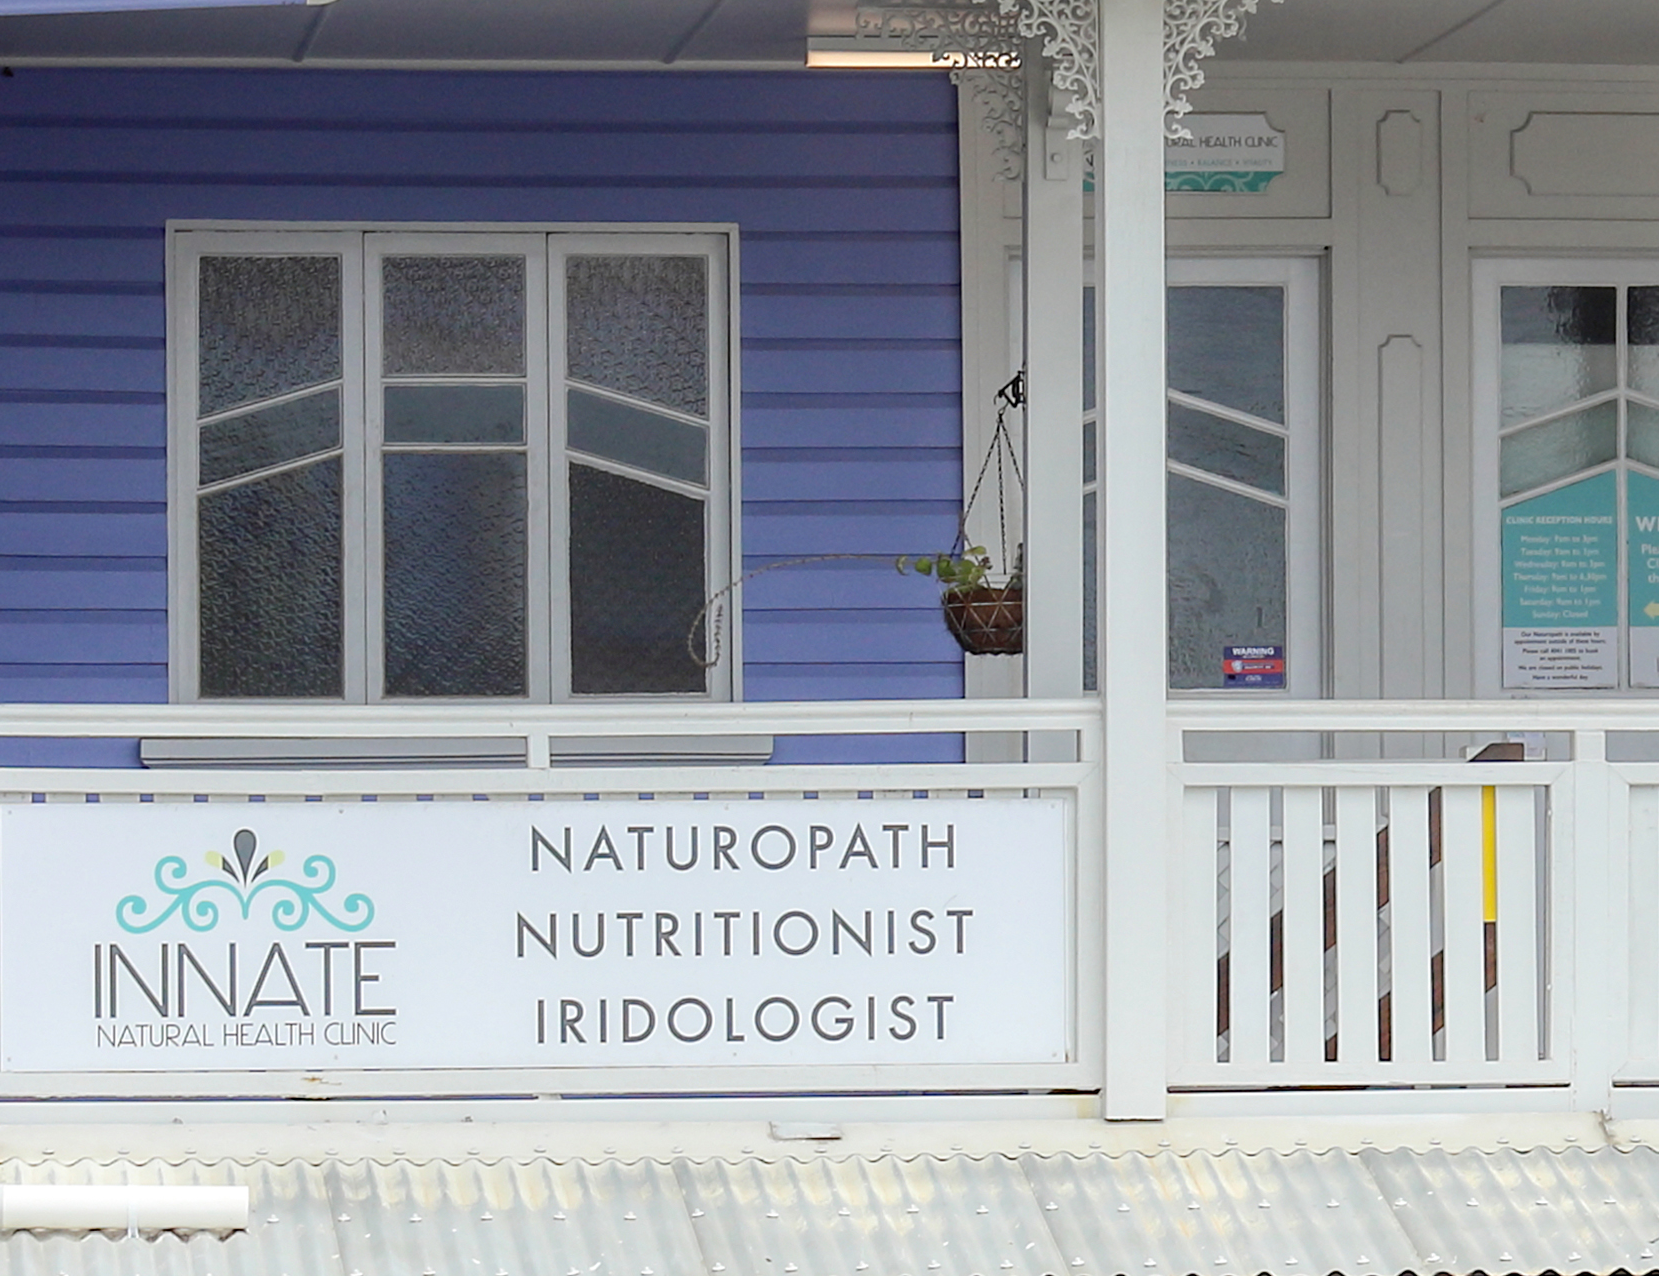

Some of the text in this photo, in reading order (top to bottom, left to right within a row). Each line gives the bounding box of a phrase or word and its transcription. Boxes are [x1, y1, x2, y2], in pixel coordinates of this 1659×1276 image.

[1165, 136, 1279, 148] URAL HEALTH CLINIC
[1506, 516, 1612, 524] CLINIC RECEPTION HOURS
[1232, 647, 1274, 655] WARNING
[532, 823, 953, 873] NATUROPATH
[517, 909, 973, 959] NUTRITIONIST
[94, 941, 397, 1019] INNATE
[97, 1022, 397, 1047] NATURAL HEALTH CLINIC
[538, 995, 953, 1044] IRIDOLOGIST
